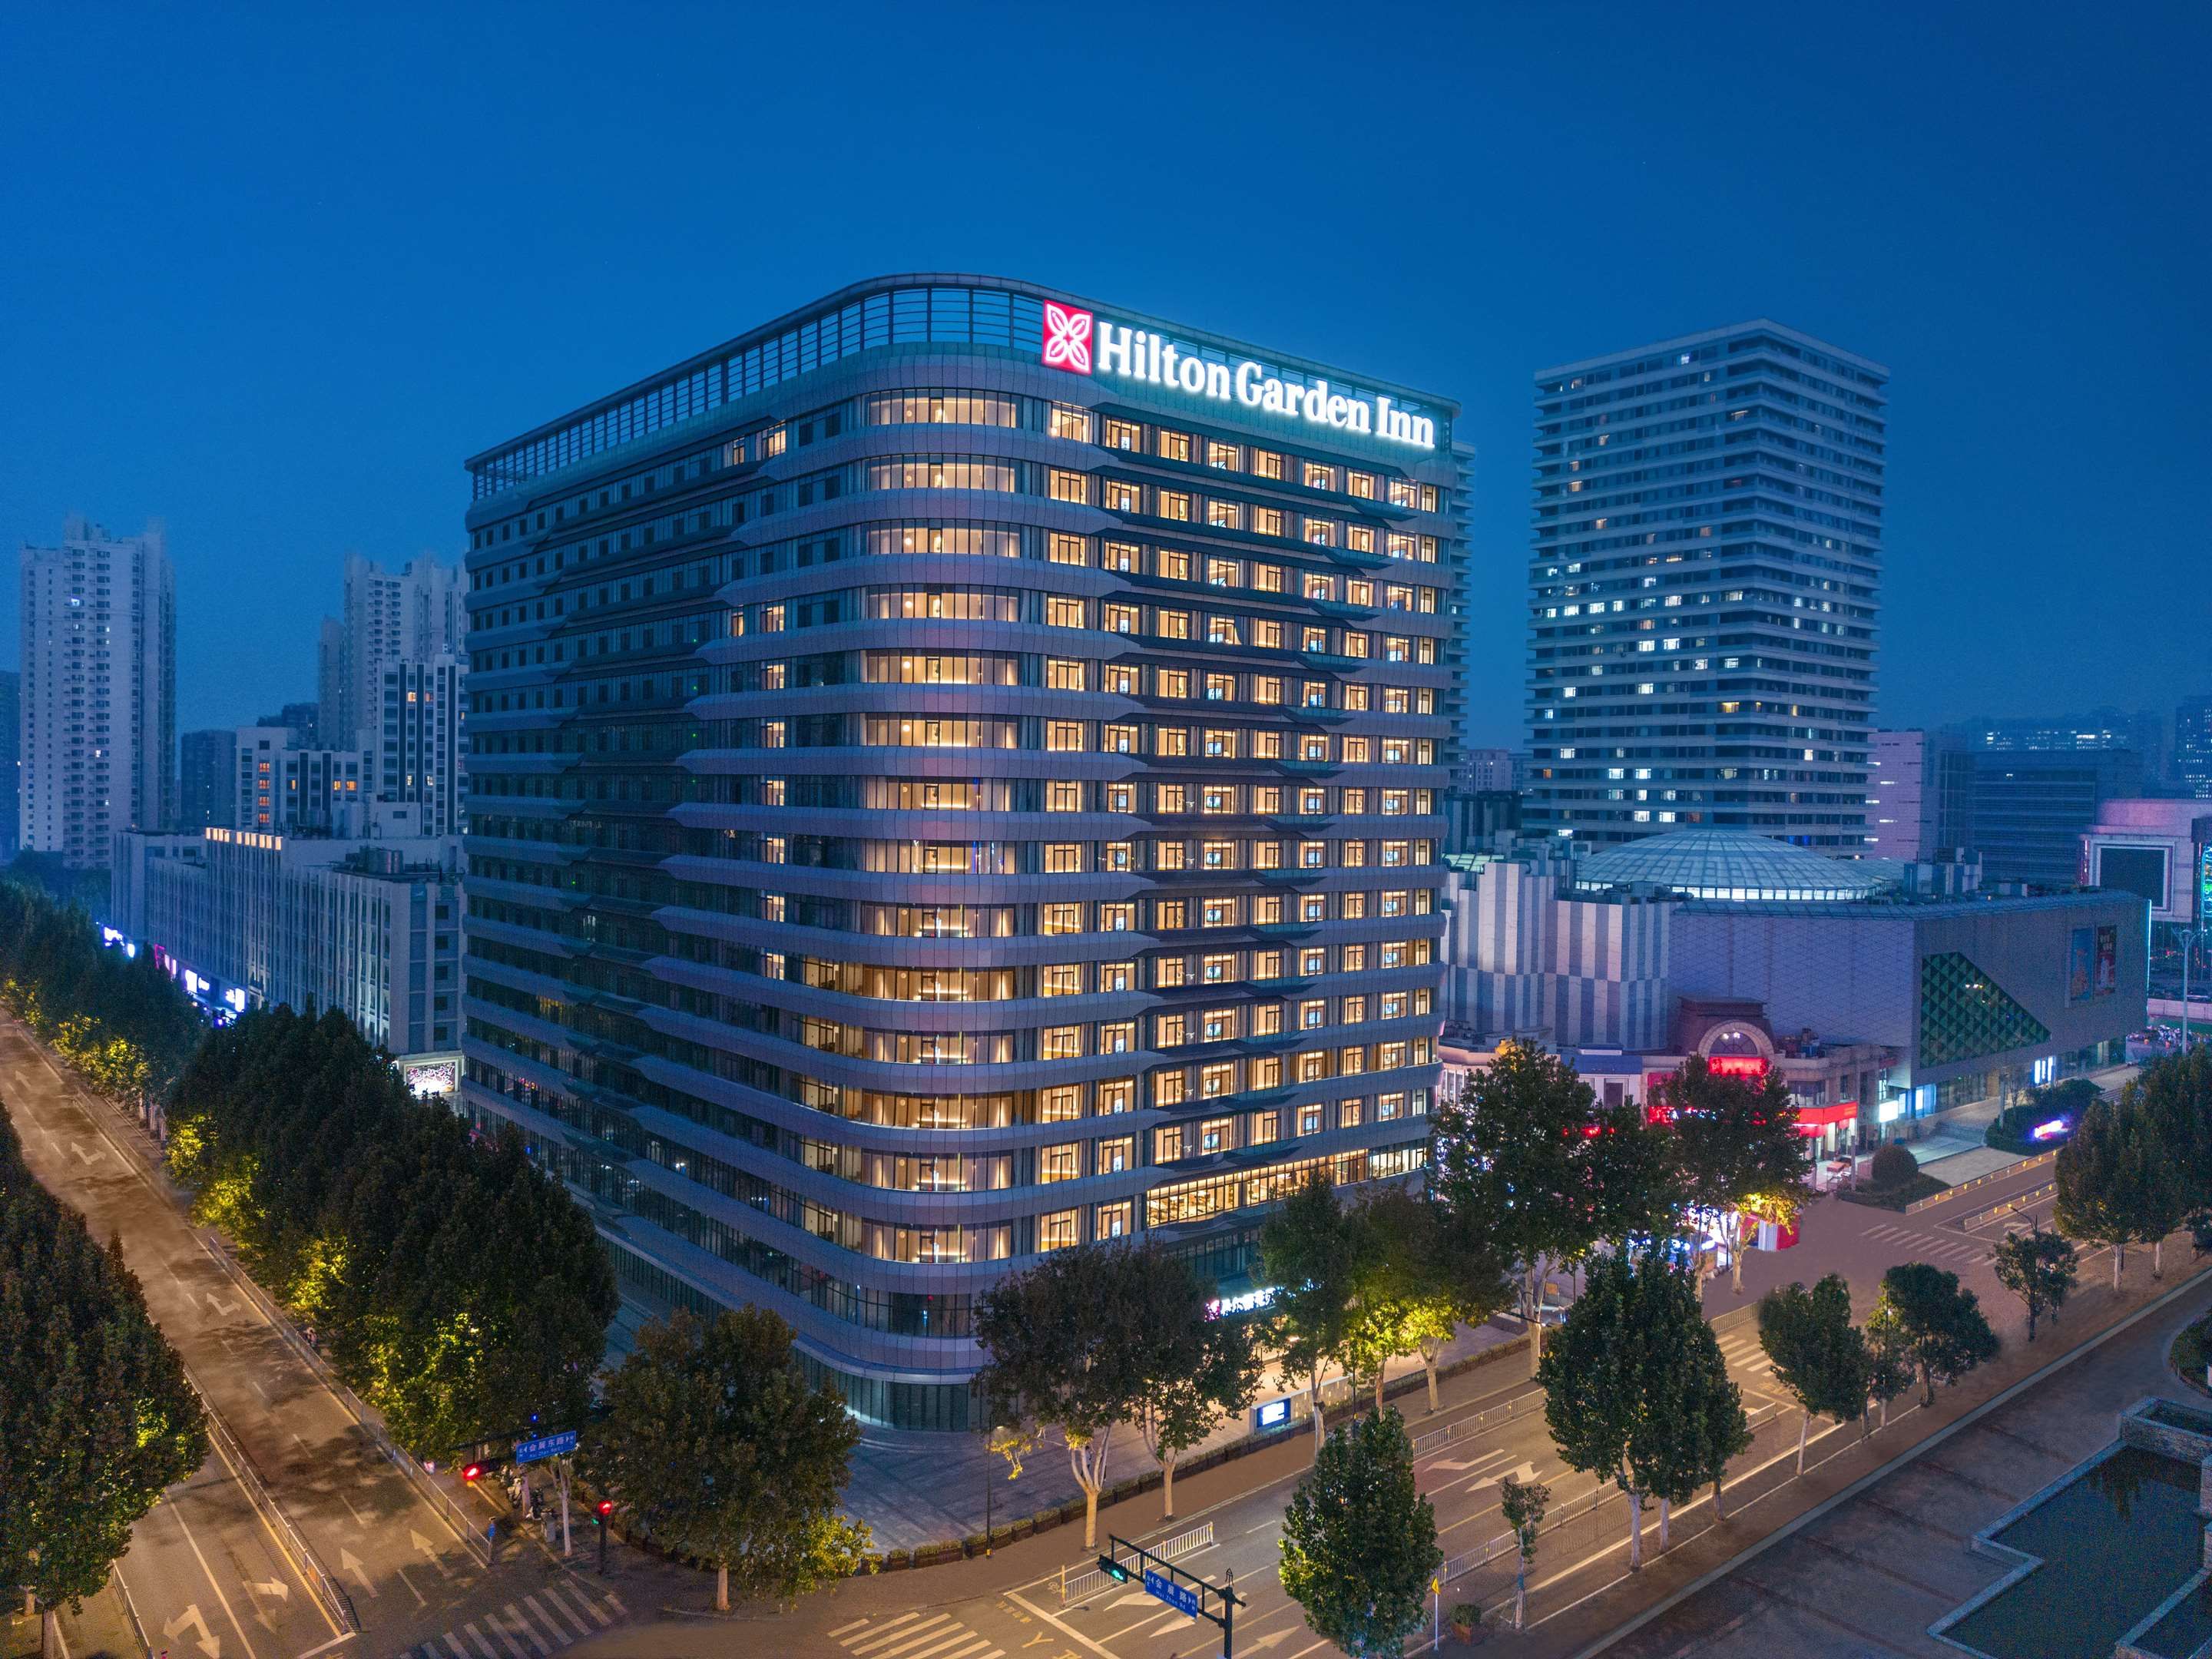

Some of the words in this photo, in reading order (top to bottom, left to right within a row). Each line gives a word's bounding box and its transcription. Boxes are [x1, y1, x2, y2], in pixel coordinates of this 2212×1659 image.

[1098, 322, 1230, 399] Hilton
[1236, 362, 1371, 433] Garden
[1376, 396, 1435, 449] Inn
[1156, 1578, 1187, 1603] 会展路
